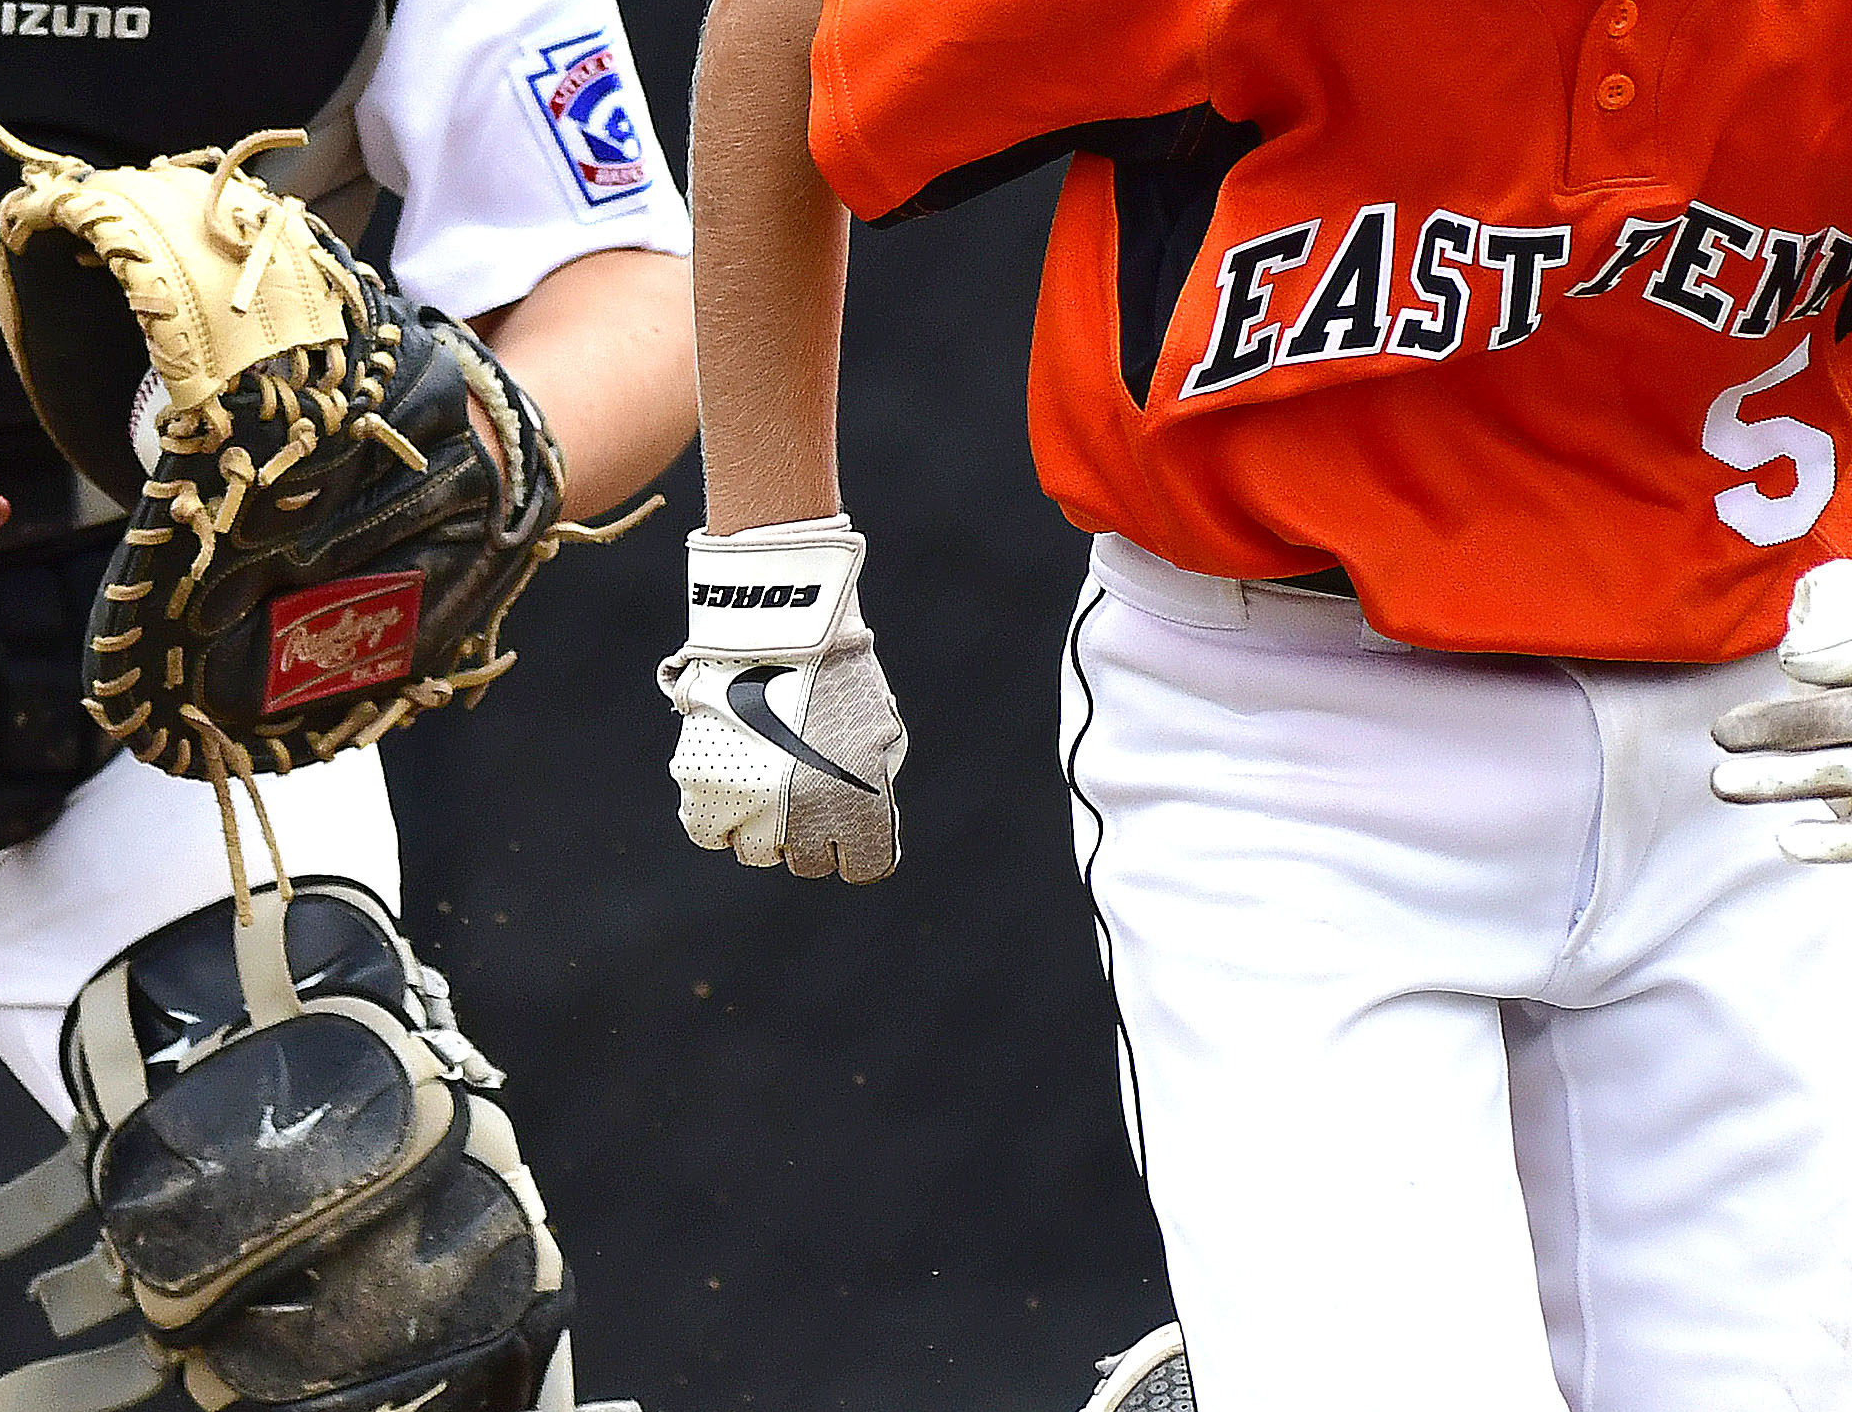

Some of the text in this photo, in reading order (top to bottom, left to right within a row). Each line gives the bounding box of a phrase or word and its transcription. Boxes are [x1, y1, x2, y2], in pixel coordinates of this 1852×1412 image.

[1177, 201, 1571, 400] EAST
[1701, 332, 1838, 548] 5
[692, 582, 822, 609] FORCE
